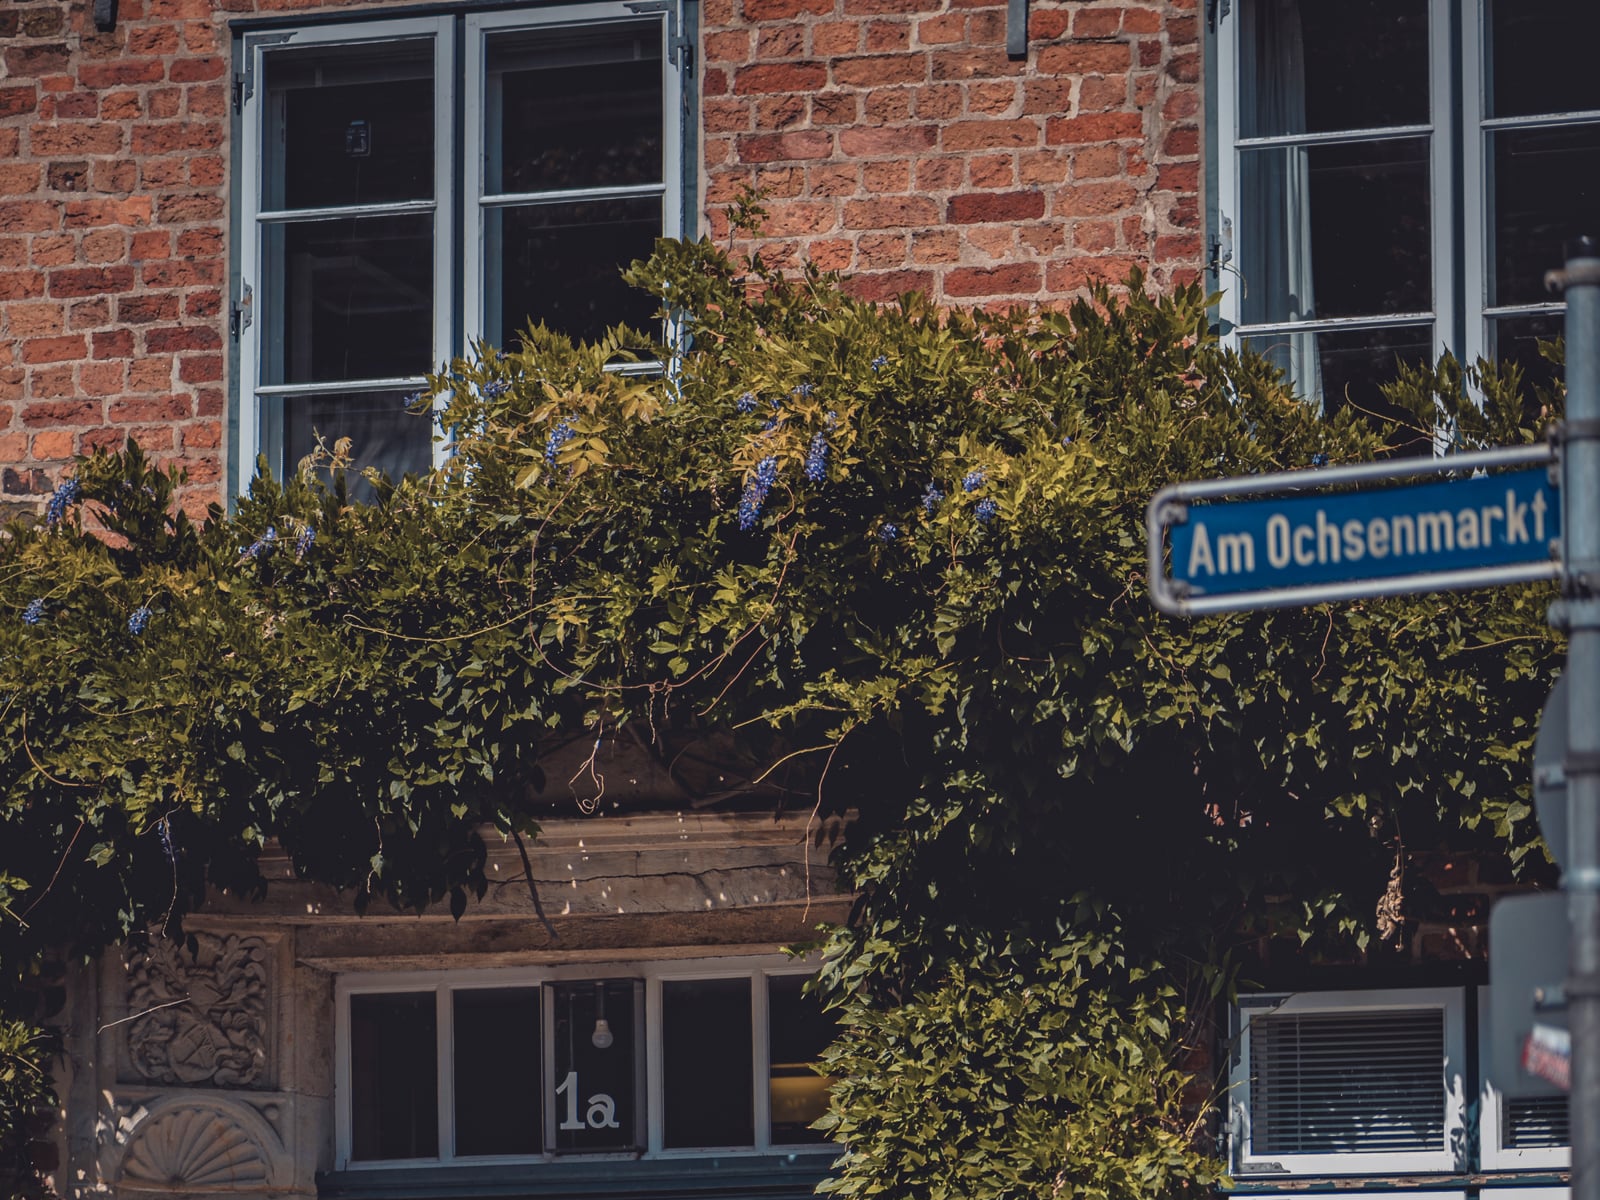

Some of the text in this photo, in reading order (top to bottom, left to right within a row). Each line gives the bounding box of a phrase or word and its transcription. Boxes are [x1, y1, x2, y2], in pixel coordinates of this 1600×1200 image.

[1188, 488, 1548, 577] Am Ochsenmarkt
[555, 1071, 620, 1130] 1a
